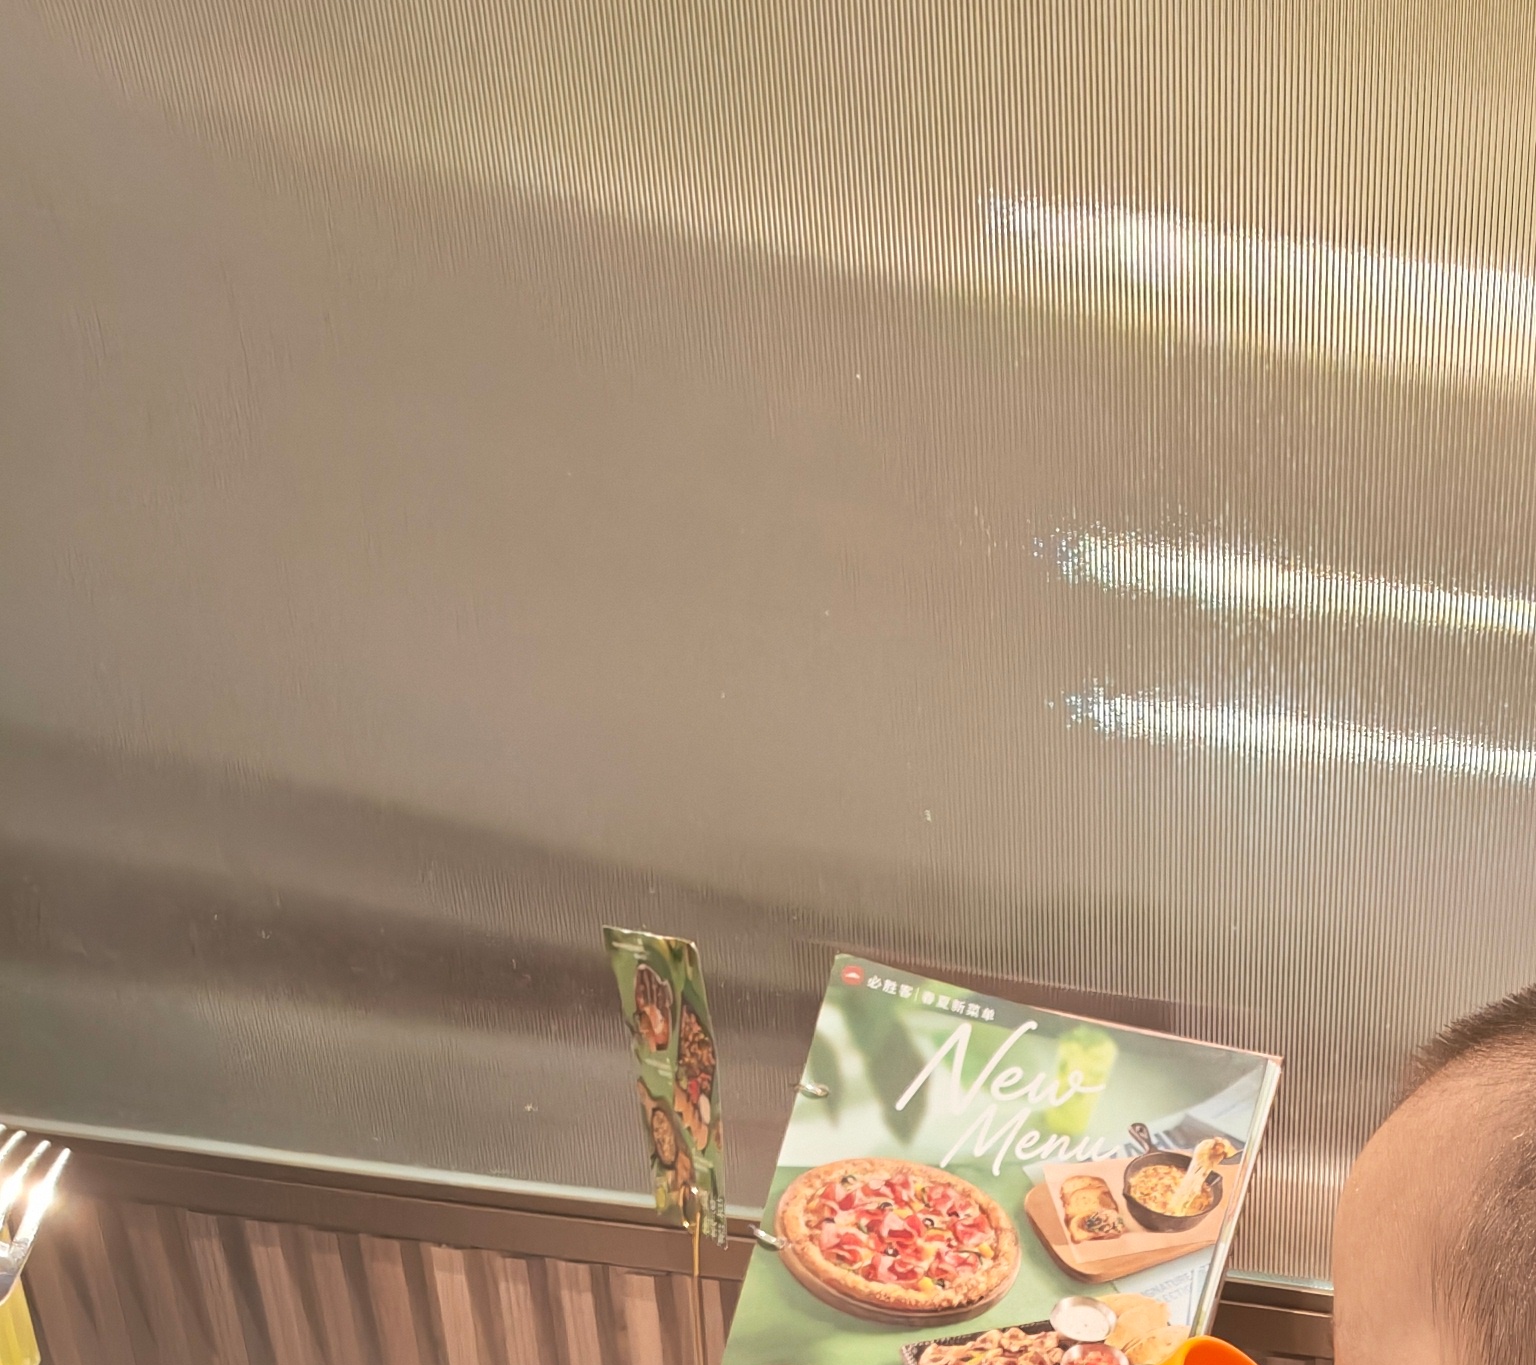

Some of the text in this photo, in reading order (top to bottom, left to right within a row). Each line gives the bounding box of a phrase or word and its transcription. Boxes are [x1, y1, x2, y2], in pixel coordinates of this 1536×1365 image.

[867, 975, 914, 998] 必胜客
[895, 1020, 1107, 1115] New
[939, 1103, 1121, 1177] Menu
